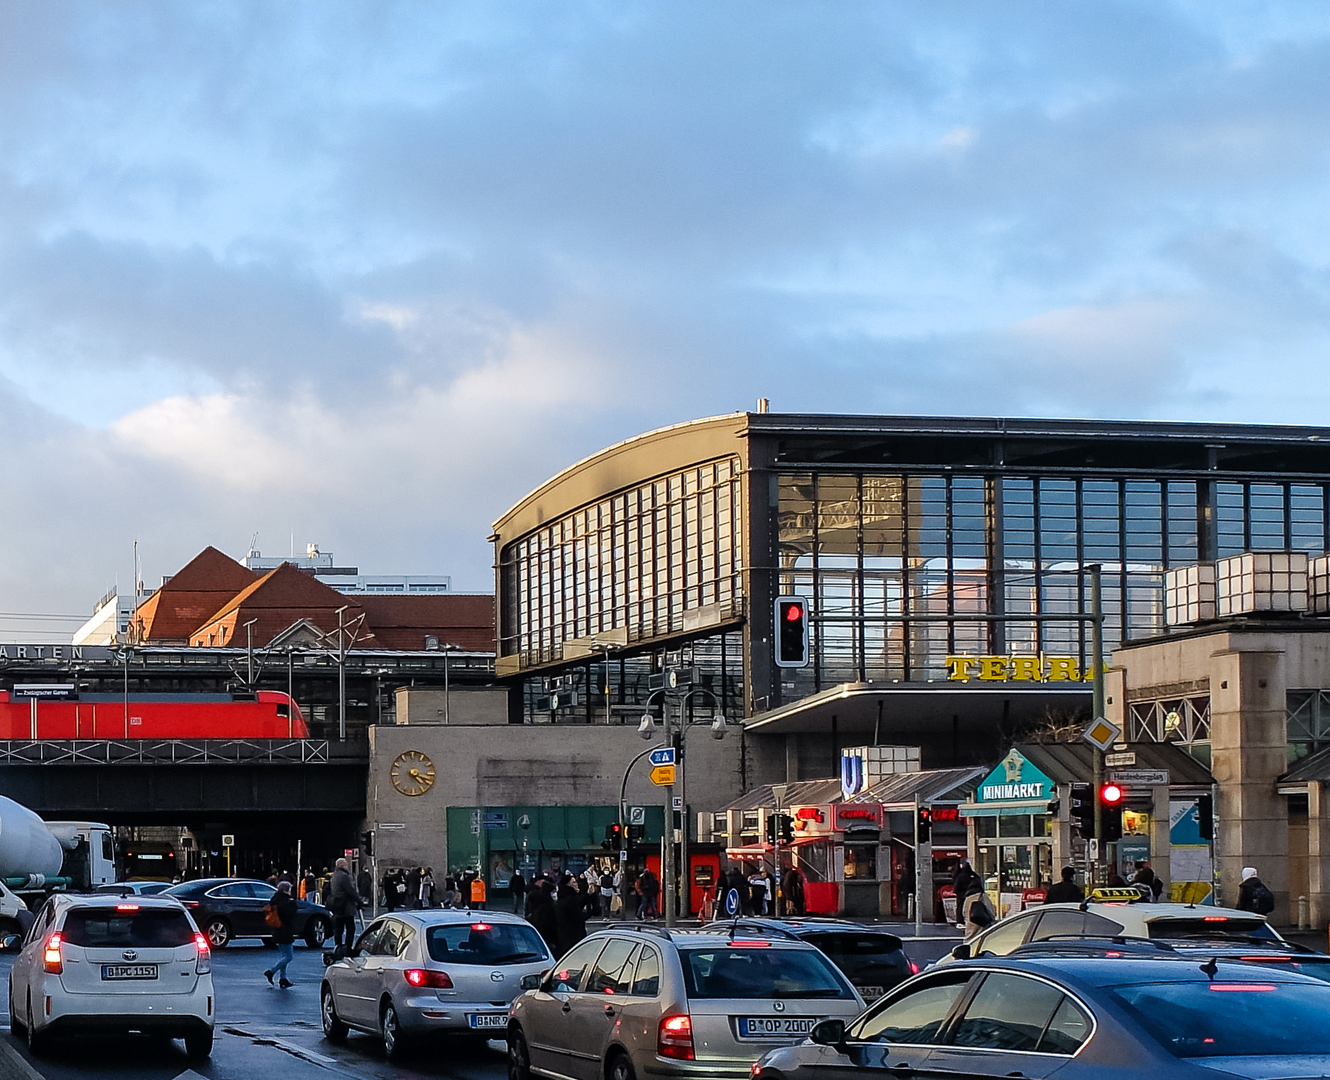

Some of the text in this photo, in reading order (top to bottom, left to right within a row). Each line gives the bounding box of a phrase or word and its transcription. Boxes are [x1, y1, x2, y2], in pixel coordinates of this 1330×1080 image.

[841, 756, 863, 795] U
[983, 783, 1042, 800] MINIMARKT
[133, 966, 156, 976] 1151
[749, 1020, 756, 1031] B
[765, 1020, 781, 1032] OP
